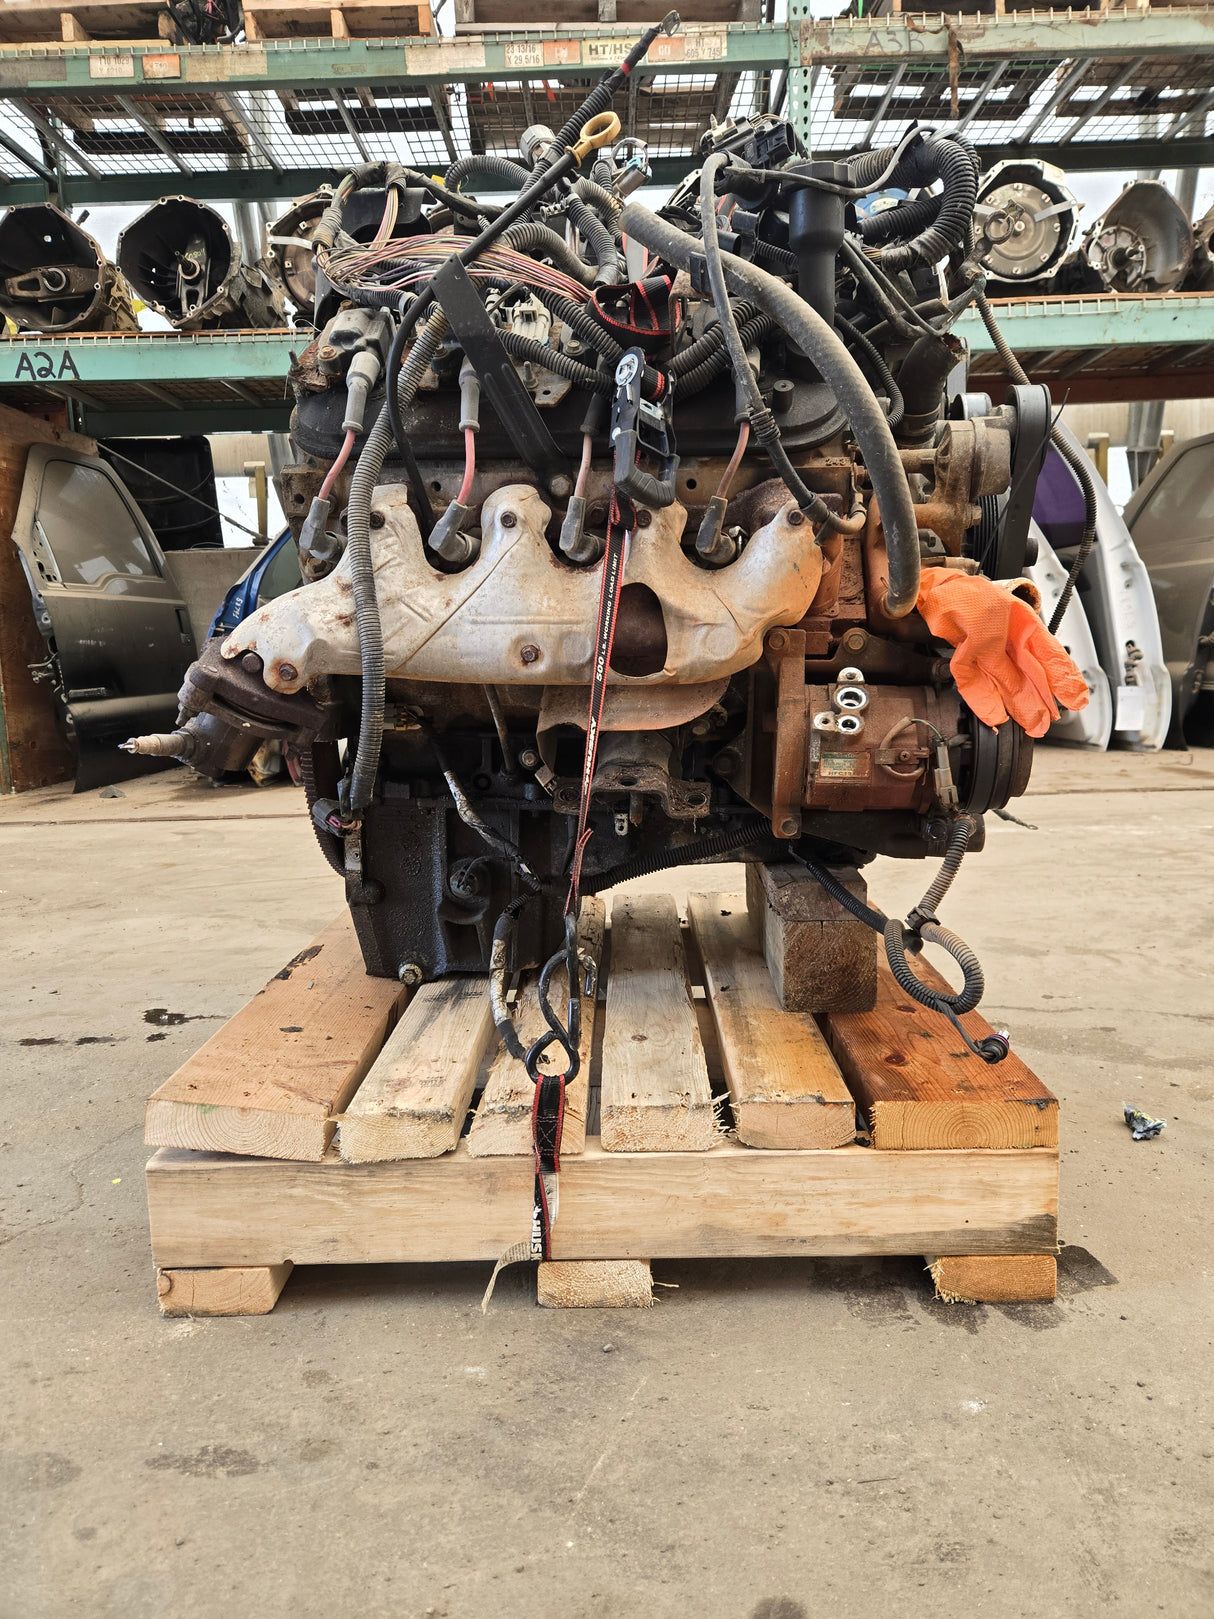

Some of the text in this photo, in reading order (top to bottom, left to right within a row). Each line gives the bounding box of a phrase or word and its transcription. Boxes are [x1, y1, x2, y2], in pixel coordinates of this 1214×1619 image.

[506, 43, 537, 53] 23 13/16
[514, 56, 523, 65] 29
[525, 55, 540, 64] 5/16
[588, 42, 633, 56] HT/HS
[15, 350, 81, 381] A2A
[611, 552, 619, 576] LIMIT
[608, 575, 616, 599] LOAD
[603, 600, 612, 640] WORKING
[596, 656, 605, 682] 500
